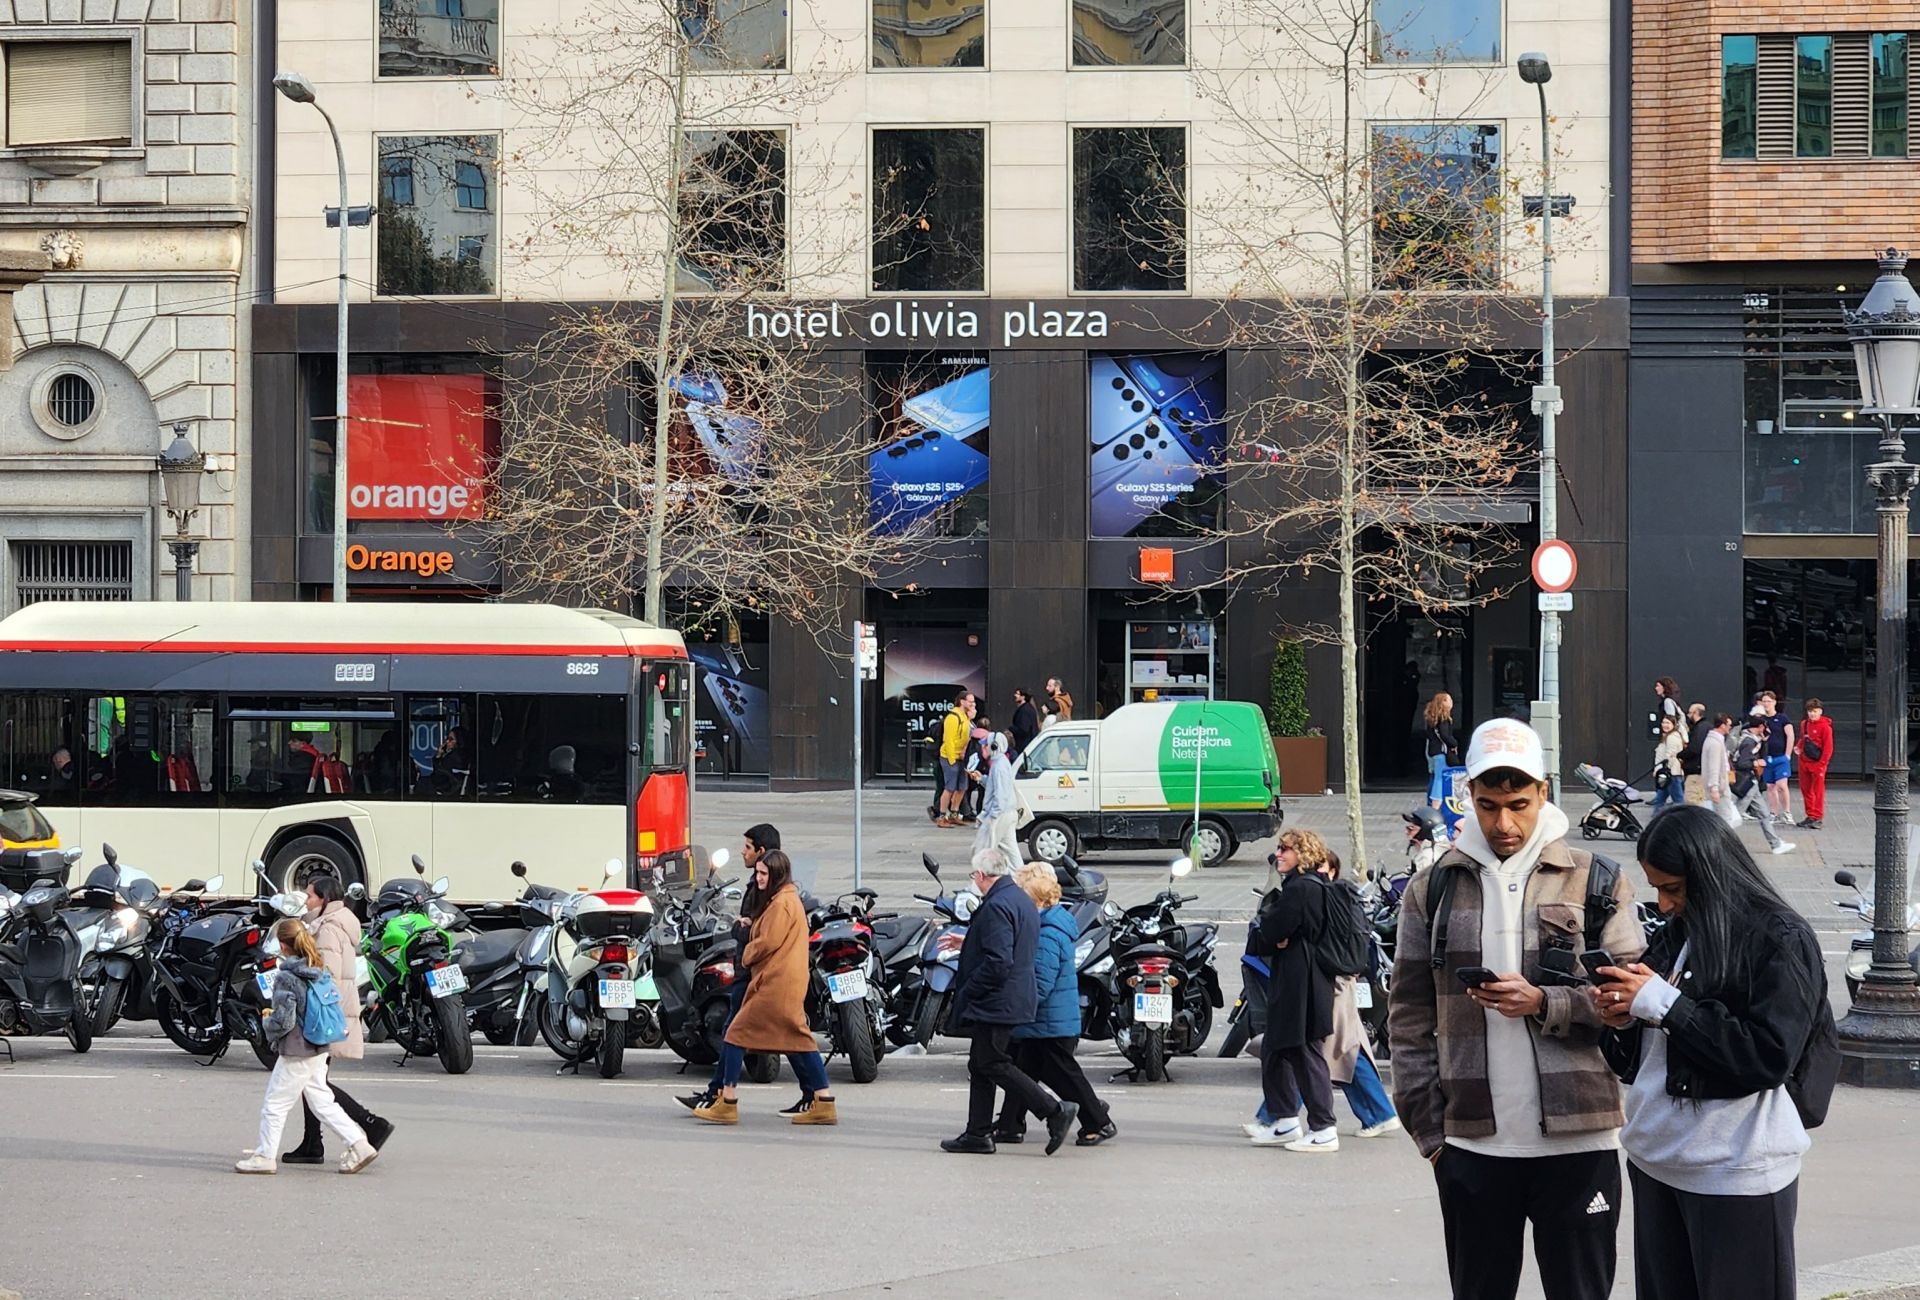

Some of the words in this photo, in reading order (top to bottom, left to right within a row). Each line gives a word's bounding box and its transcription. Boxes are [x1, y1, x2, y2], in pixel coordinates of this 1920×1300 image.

[748, 302, 842, 338] hotel
[870, 301, 978, 337] olivia
[1004, 301, 1109, 347] plaza
[942, 357, 987, 365] SAMSUNG
[892, 482, 925, 493] Galaxy
[925, 482, 941, 491] S25
[1116, 483, 1148, 493] Galaxy
[1149, 483, 1165, 492] S25
[1166, 483, 1194, 492] Series
[350, 484, 468, 515] orange
[906, 494, 933, 503] Galaxy
[1133, 494, 1160, 503] Galaxy
[1725, 542, 1738, 551] 20
[346, 544, 454, 577] Orange
[1142, 571, 1170, 580] orange
[566, 662, 599, 675] 8625
[902, 700, 925, 711] Ens
[1172, 725, 1218, 736] Cuidem
[1172, 736, 1232, 747] Barcelona
[1145, 996, 1169, 1006] 1247
